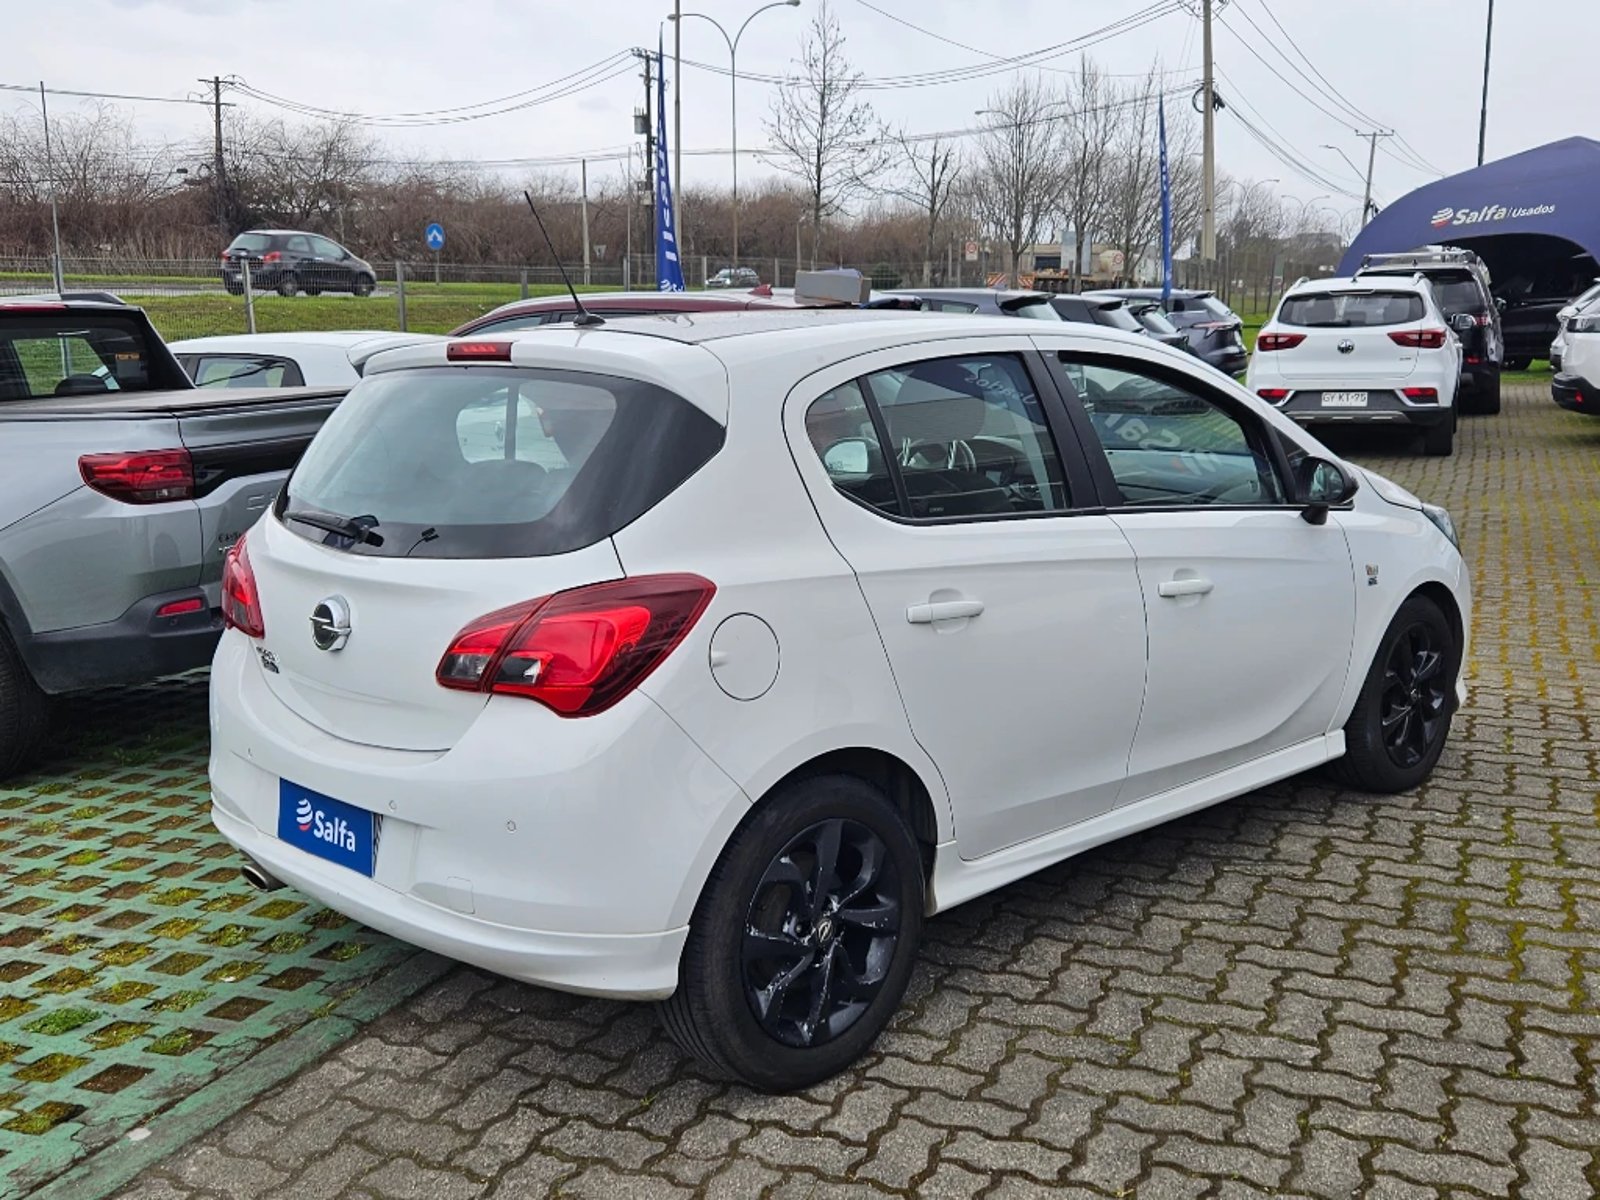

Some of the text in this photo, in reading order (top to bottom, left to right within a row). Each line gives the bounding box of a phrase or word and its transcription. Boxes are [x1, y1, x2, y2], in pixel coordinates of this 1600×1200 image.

[1452, 204, 1556, 225] Salfa Usados
[313, 810, 356, 852] Salfa
